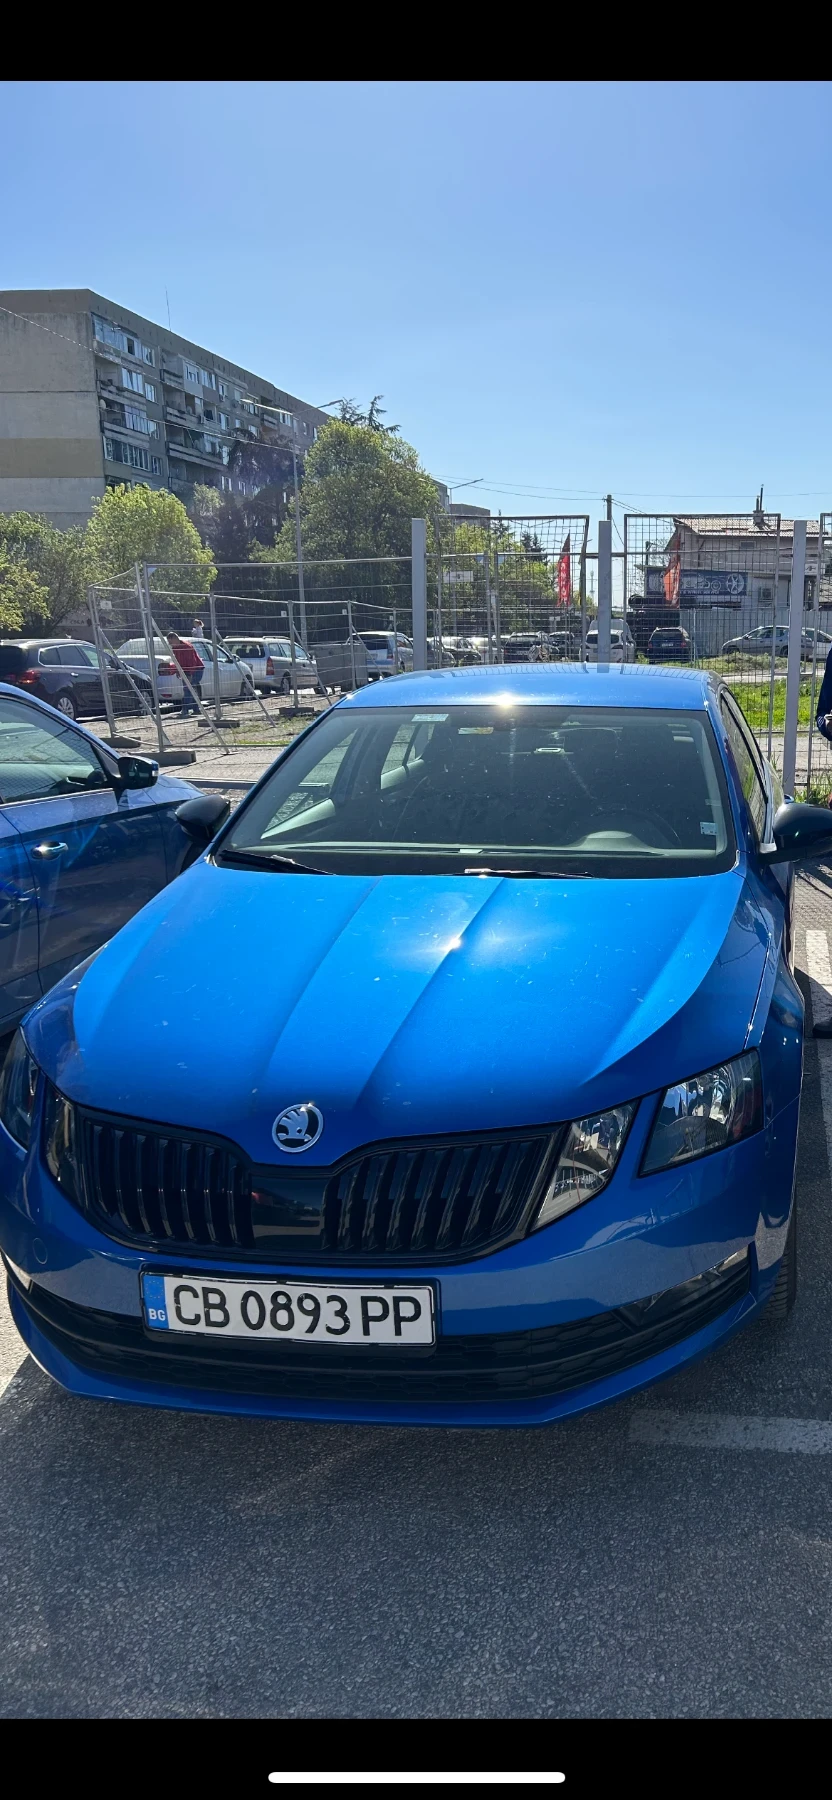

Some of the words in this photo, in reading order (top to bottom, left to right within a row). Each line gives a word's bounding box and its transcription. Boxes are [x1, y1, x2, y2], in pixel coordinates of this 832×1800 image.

[148, 1307, 166, 1322] BG
[173, 1284, 231, 1328] CB
[240, 1290, 351, 1336] 0893
[360, 1295, 422, 1337] PP
